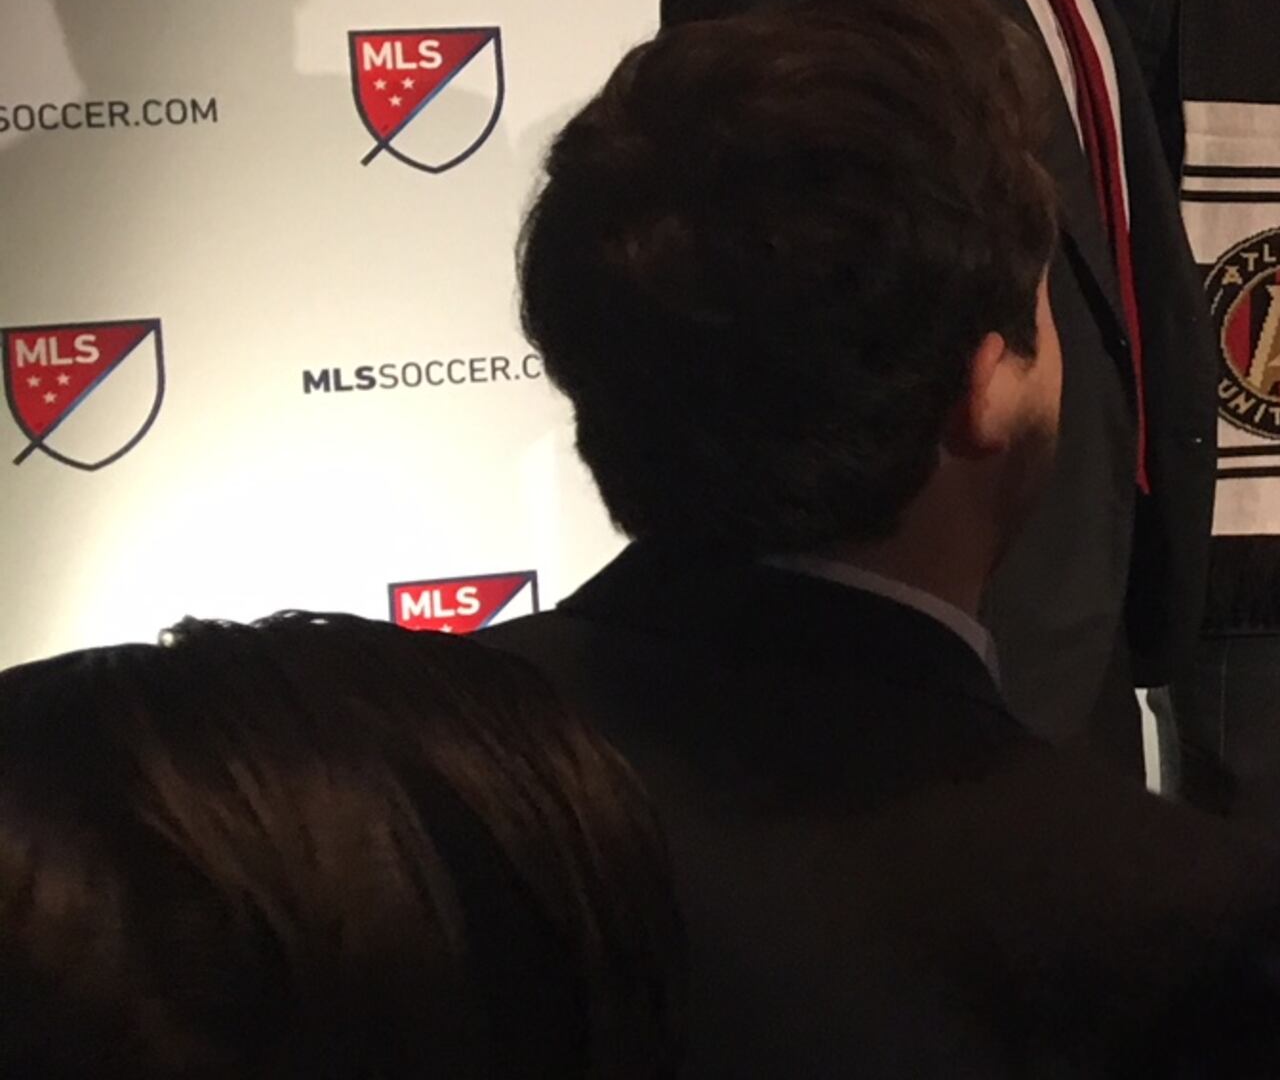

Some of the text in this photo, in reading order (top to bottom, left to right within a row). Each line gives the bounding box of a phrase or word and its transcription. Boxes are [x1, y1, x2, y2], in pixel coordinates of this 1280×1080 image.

[362, 39, 443, 71] MLS
[0, 98, 218, 133] SOCCER.COM
[16, 334, 100, 367] MLS
[303, 355, 540, 394] MLSSOCCER.C
[401, 586, 480, 621] MLS
